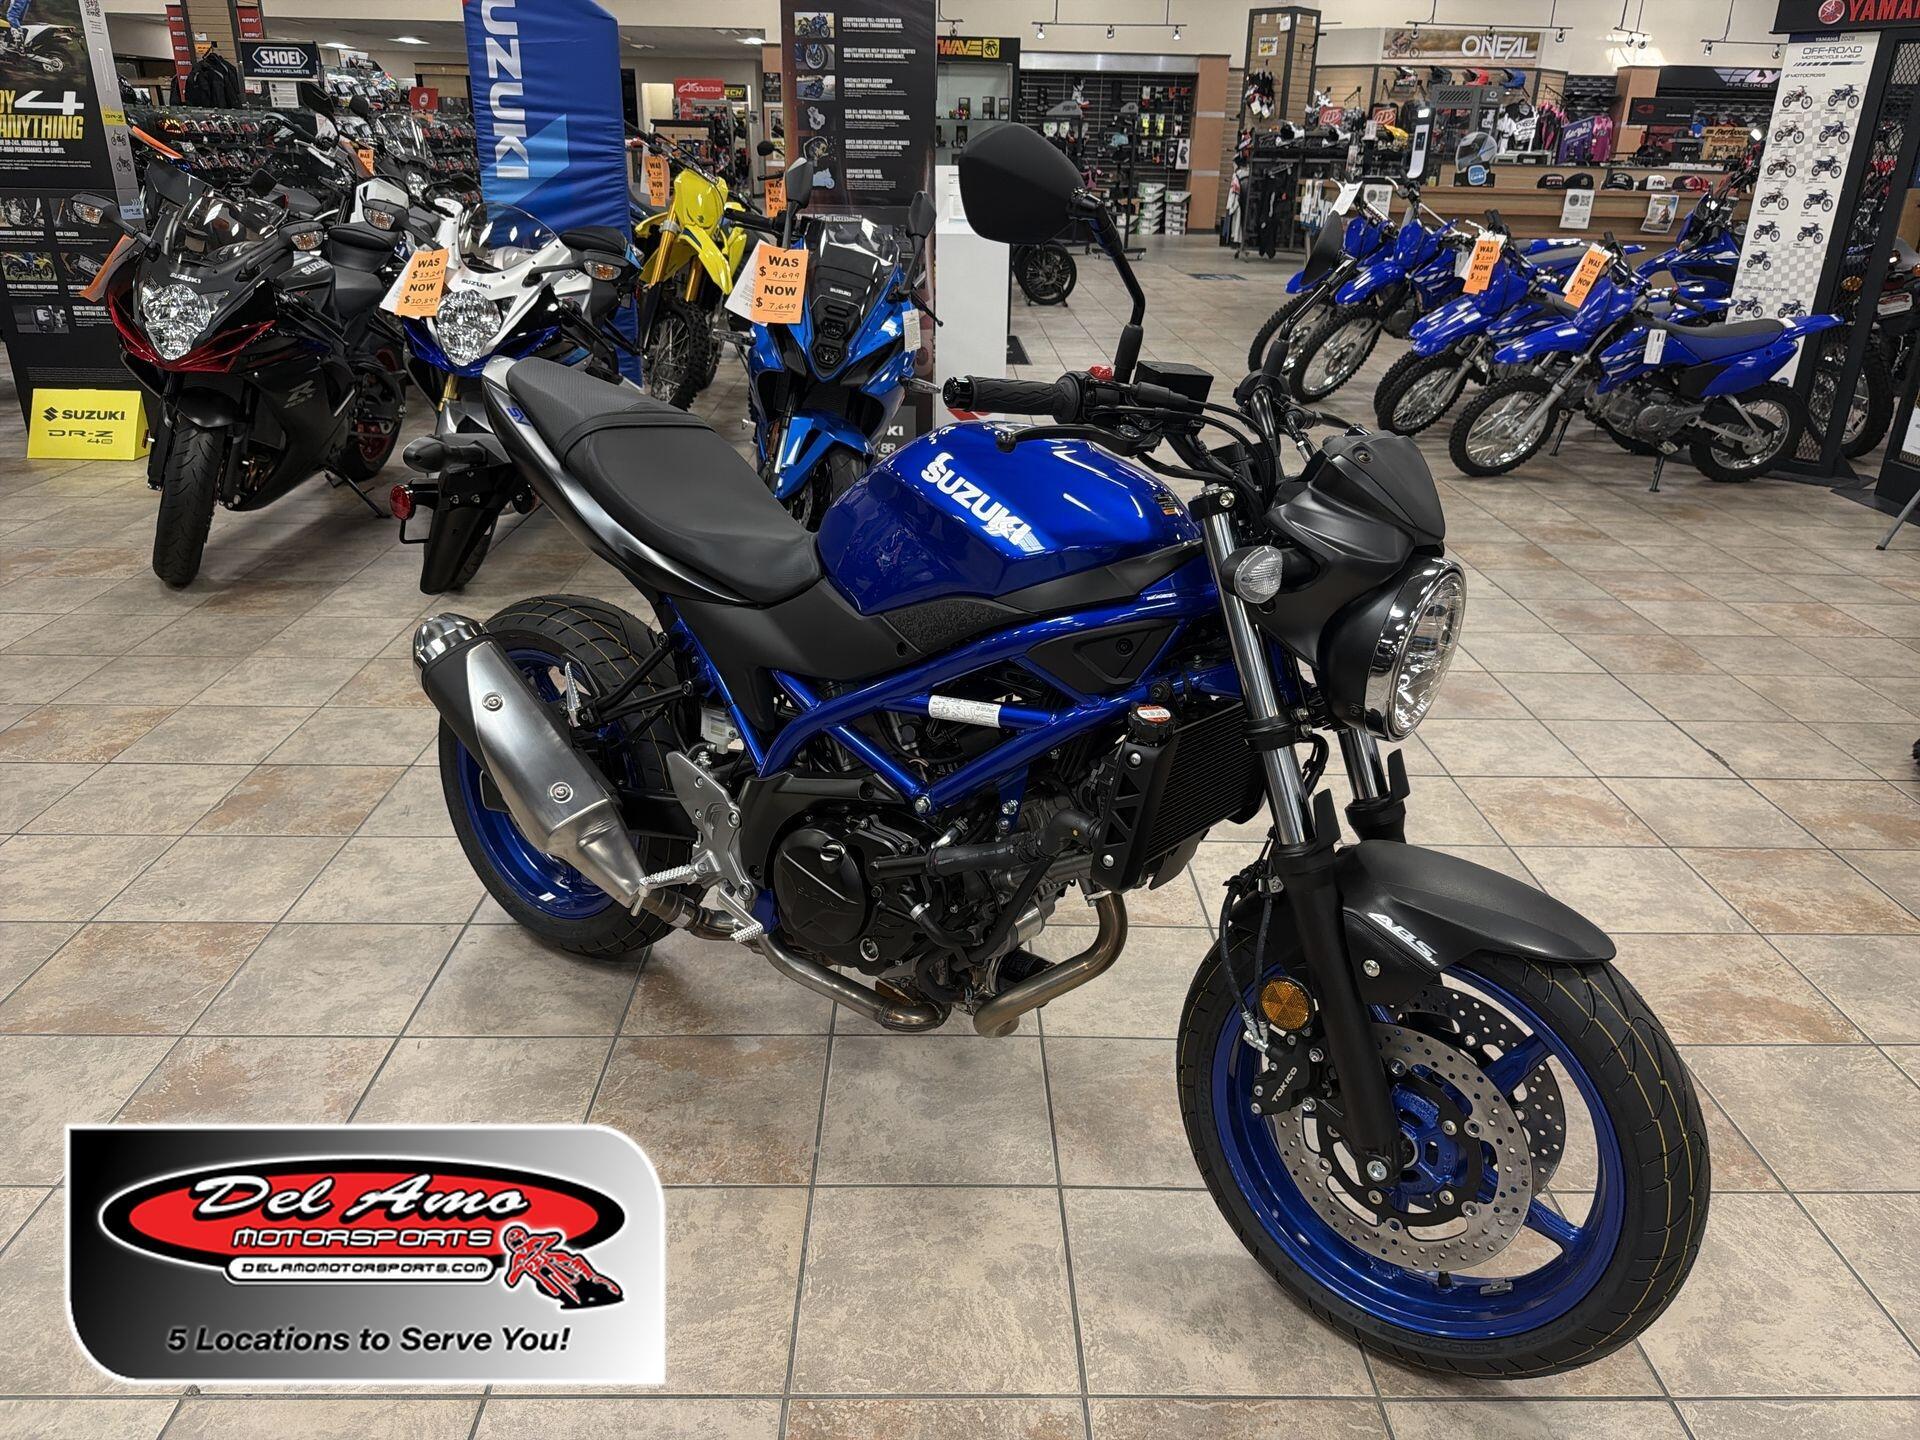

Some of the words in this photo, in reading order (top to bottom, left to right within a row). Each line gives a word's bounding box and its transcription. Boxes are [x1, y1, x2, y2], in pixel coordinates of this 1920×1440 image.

[1802, 46, 1863, 55] OFF-ROAD
[260, 50, 301, 64] SHOEI
[14, 90, 84, 116] 4
[0, 114, 84, 140] ANYTHING
[418, 258, 440, 268] WAS
[768, 255, 799, 268] WAS
[1588, 257, 1601, 268] WAS
[412, 271, 418, 279] $
[759, 266, 766, 277] $
[170, 272, 201, 284] SUZUKI
[409, 283, 436, 292] NOW
[461, 279, 492, 290] SUZUKI
[764, 284, 797, 297] NOW
[830, 287, 852, 297] SUZUKI
[404, 295, 410, 304] $
[756, 297, 763, 308] $
[769, 302, 796, 311] 7,649
[62, 410, 125, 420] SUZUKI
[886, 425, 904, 436] KI
[921, 452, 1031, 546] SUZUKI
[1368, 912, 1439, 967] ABS
[1272, 1066, 1298, 1102] TOKICO
